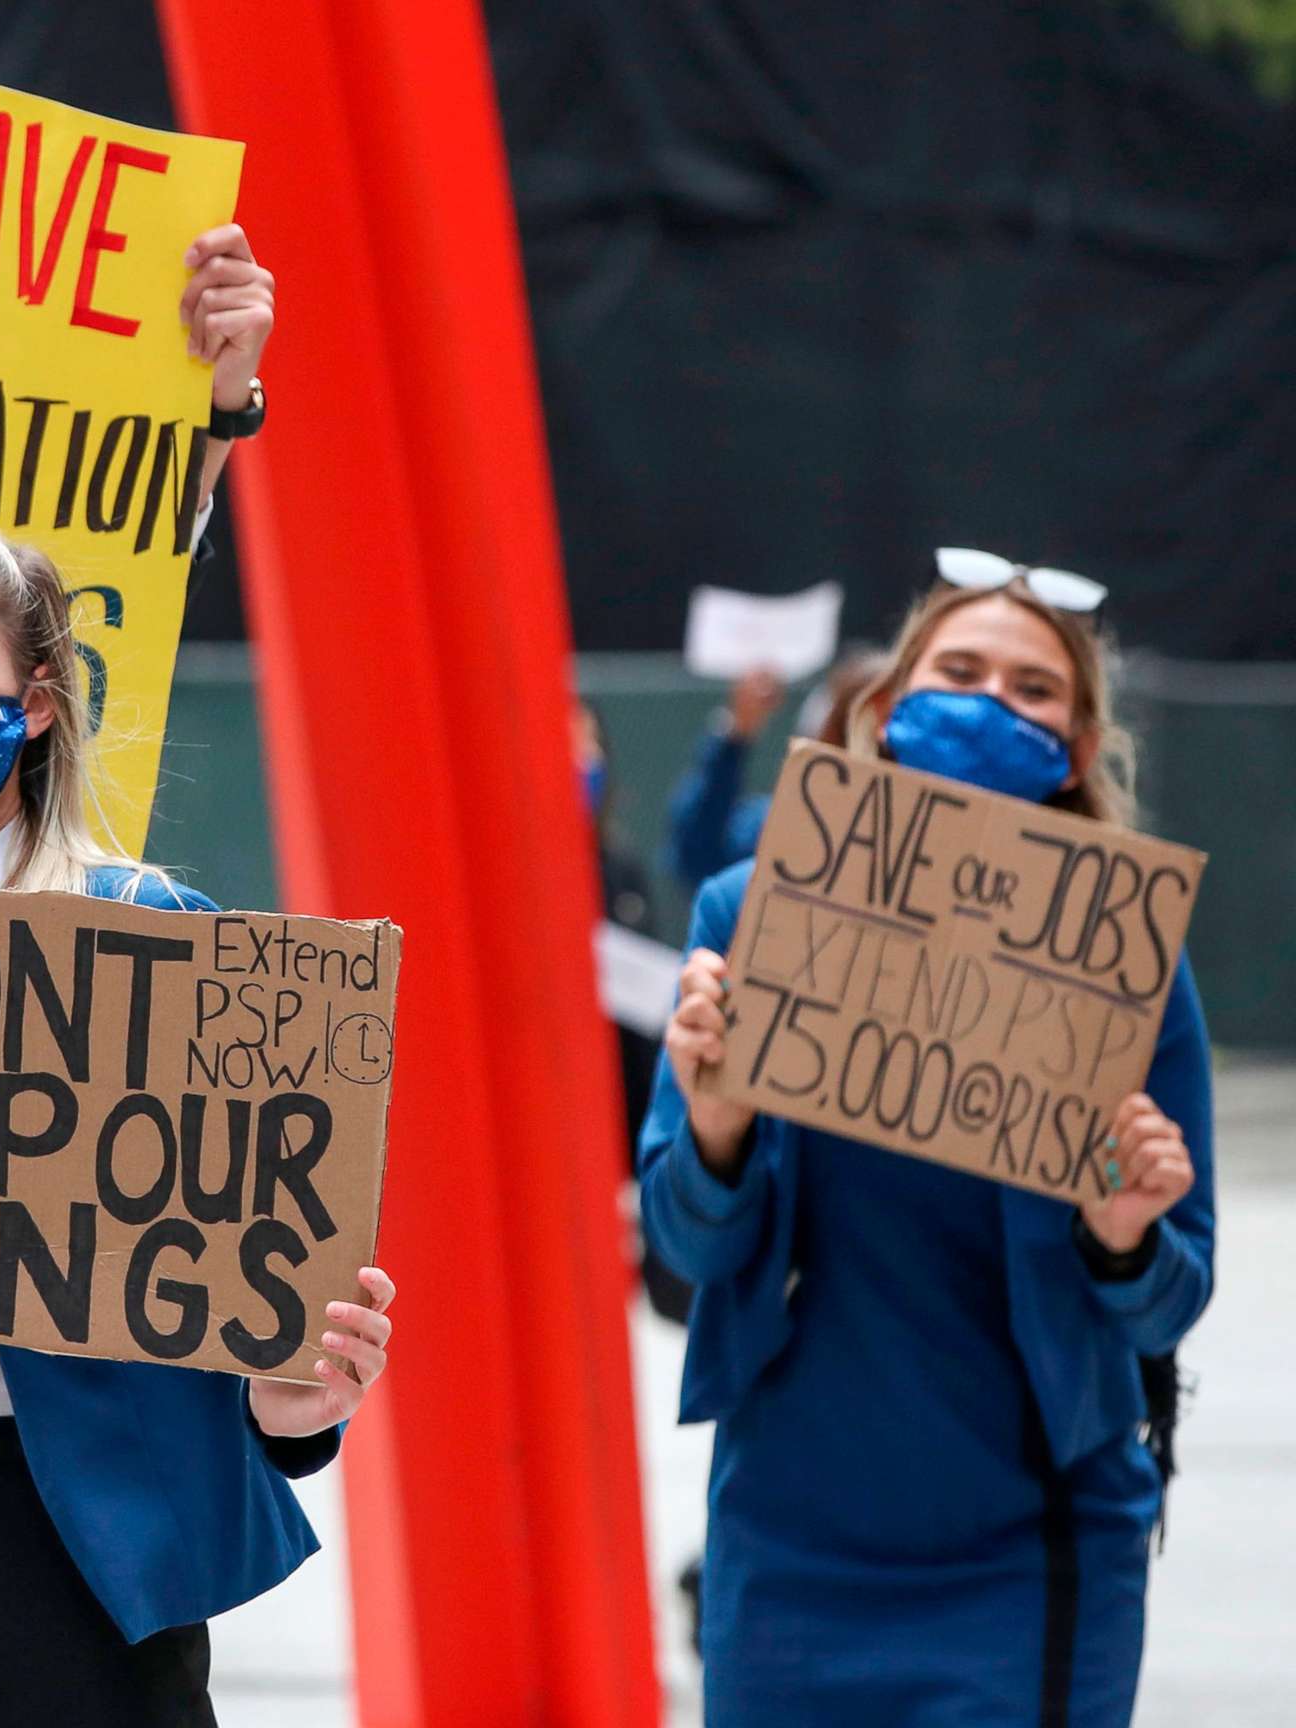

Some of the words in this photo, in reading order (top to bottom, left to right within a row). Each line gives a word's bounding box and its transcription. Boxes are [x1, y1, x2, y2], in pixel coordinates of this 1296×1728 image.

[773, 754, 967, 924] SAVE
[998, 829, 1189, 1001] JOBS
[196, 979, 303, 1048] PSP
[744, 890, 991, 1040] EXTEND
[1000, 970, 1138, 1088] PSP
[95, 1093, 337, 1240] OUR
